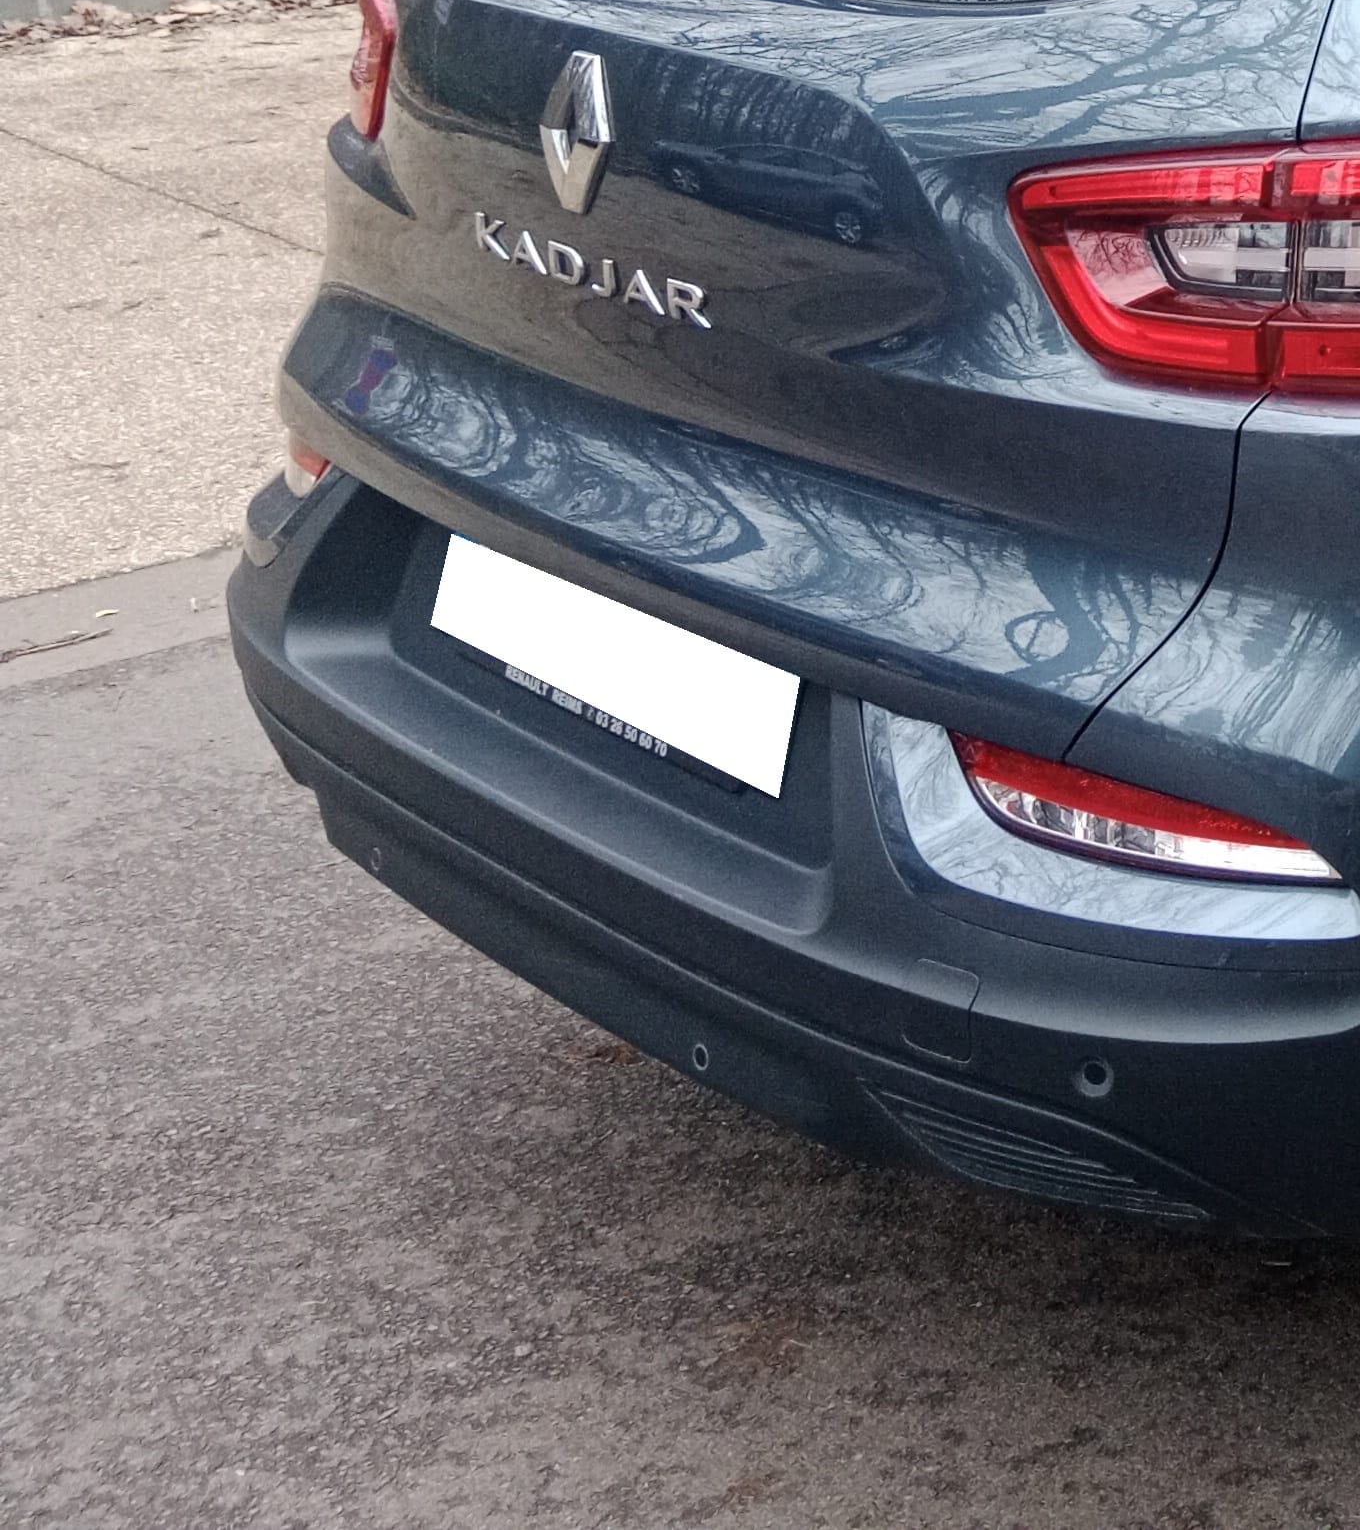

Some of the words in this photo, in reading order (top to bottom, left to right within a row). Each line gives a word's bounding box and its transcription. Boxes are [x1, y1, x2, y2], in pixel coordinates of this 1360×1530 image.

[473, 211, 712, 330] KADJAR
[504, 664, 550, 697] RENAULT
[551, 688, 583, 715] REIMS
[595, 710, 609, 729] 03
[624, 724, 638, 743] 50
[638, 732, 653, 750] 60
[654, 739, 668, 757] 70
